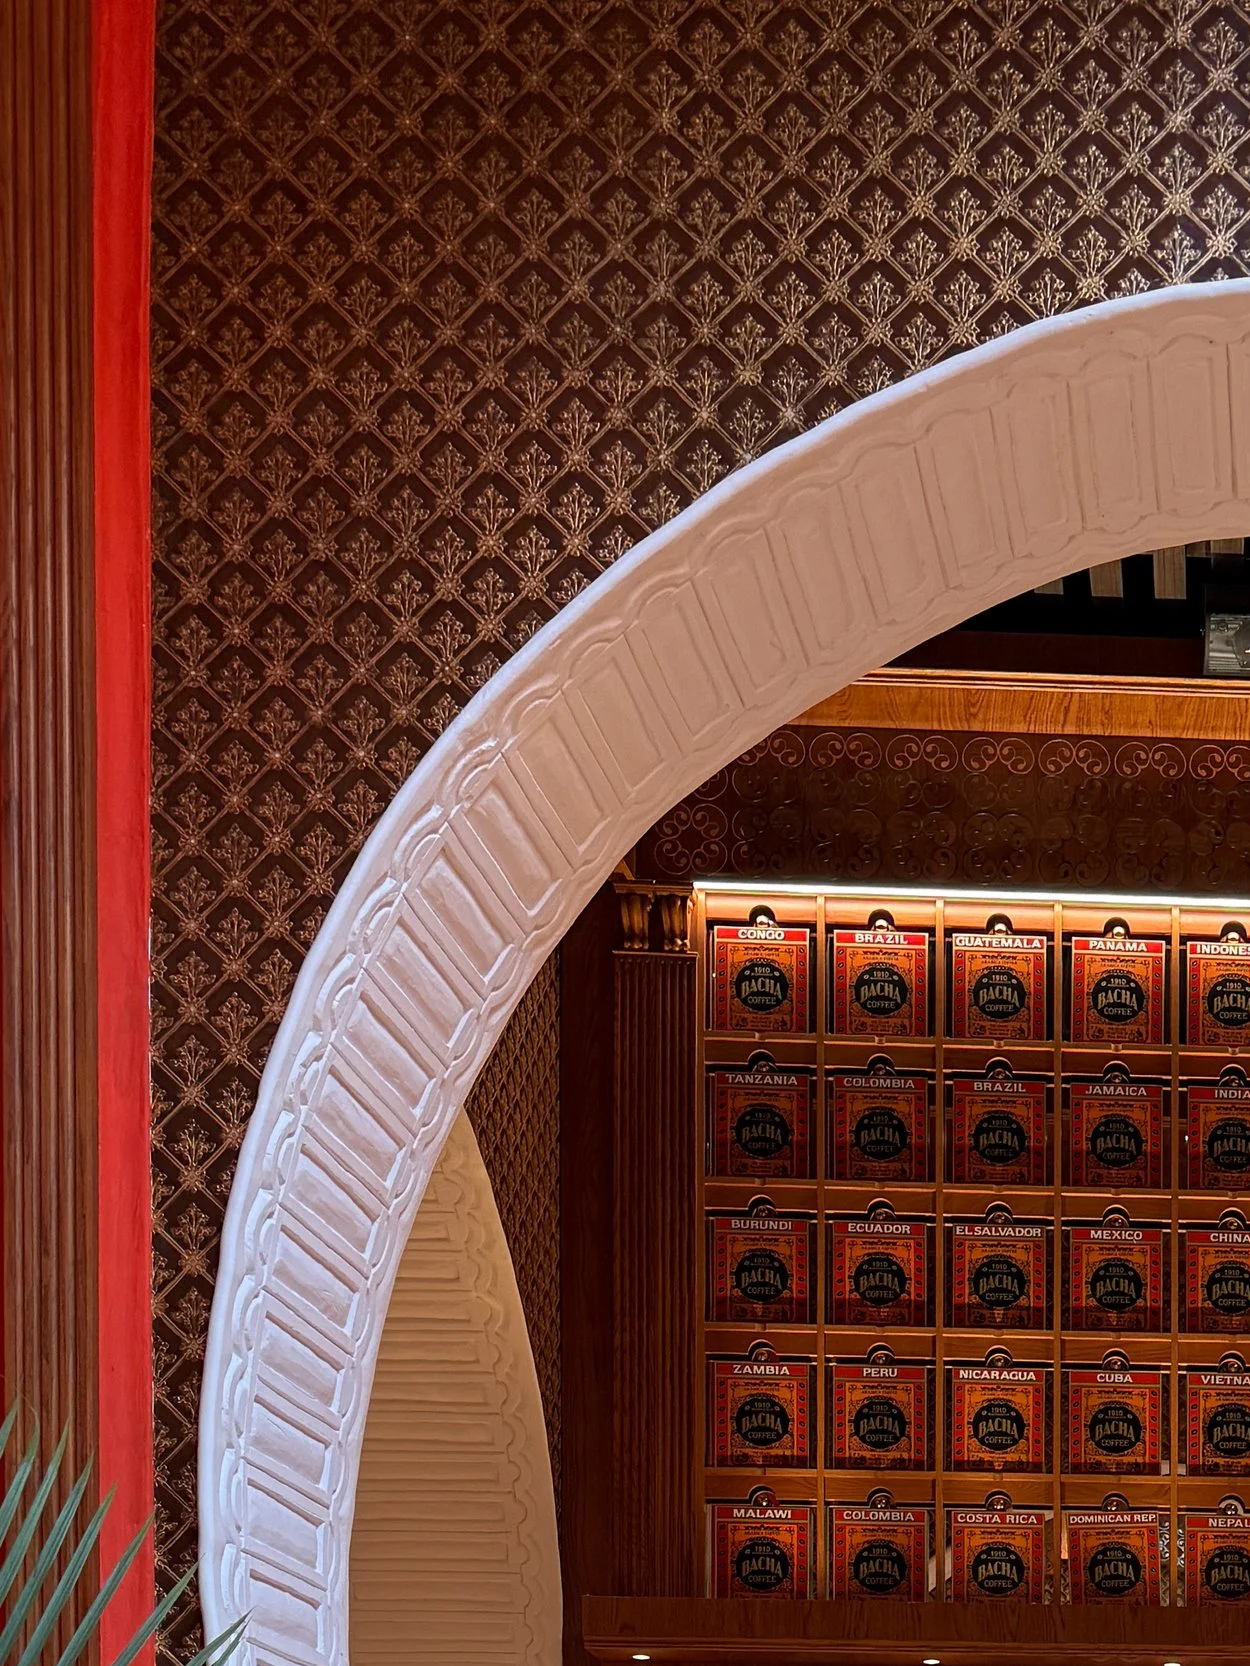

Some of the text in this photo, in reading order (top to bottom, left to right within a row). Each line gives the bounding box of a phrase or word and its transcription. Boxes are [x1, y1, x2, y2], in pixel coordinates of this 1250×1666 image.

[738, 929, 785, 940] CONGO
[855, 933, 908, 944] BRAZIL
[956, 937, 1041, 949] GUATEMALA
[1089, 941, 1147, 952] PANAMA
[741, 978, 782, 1000] BACHA
[979, 985, 1020, 1007] BACHA
[726, 1074, 797, 1085] TANZANIA
[844, 1078, 914, 1088] COLOMBIA
[974, 1082, 1026, 1091] BRAZIL
[1086, 1086, 1146, 1096] JAMAICA
[1215, 1090, 1250, 1098] INDIA
[732, 1220, 791, 1230] BURUNDI
[848, 1223, 910, 1233] ECUADOR
[956, 1227, 1041, 1236] EL SALVADOR
[1091, 1230, 1142, 1241] MEXICO
[1211, 1233, 1250, 1242] CHINA
[734, 1365, 789, 1375] ZAMBIA
[864, 1368, 897, 1377] PERU
[960, 1370, 1035, 1380] NICARAGUA
[1097, 1374, 1133, 1382] CUBA
[979, 1417, 1018, 1439] BACHA
[734, 1509, 791, 1518] MALAWI
[844, 1511, 914, 1520] COLOMBIA
[957, 1513, 1037, 1524] COSTA RICA
[1070, 1515, 1130, 1523] DOMINICAN
[1208, 1518, 1250, 1528] NEPAL
